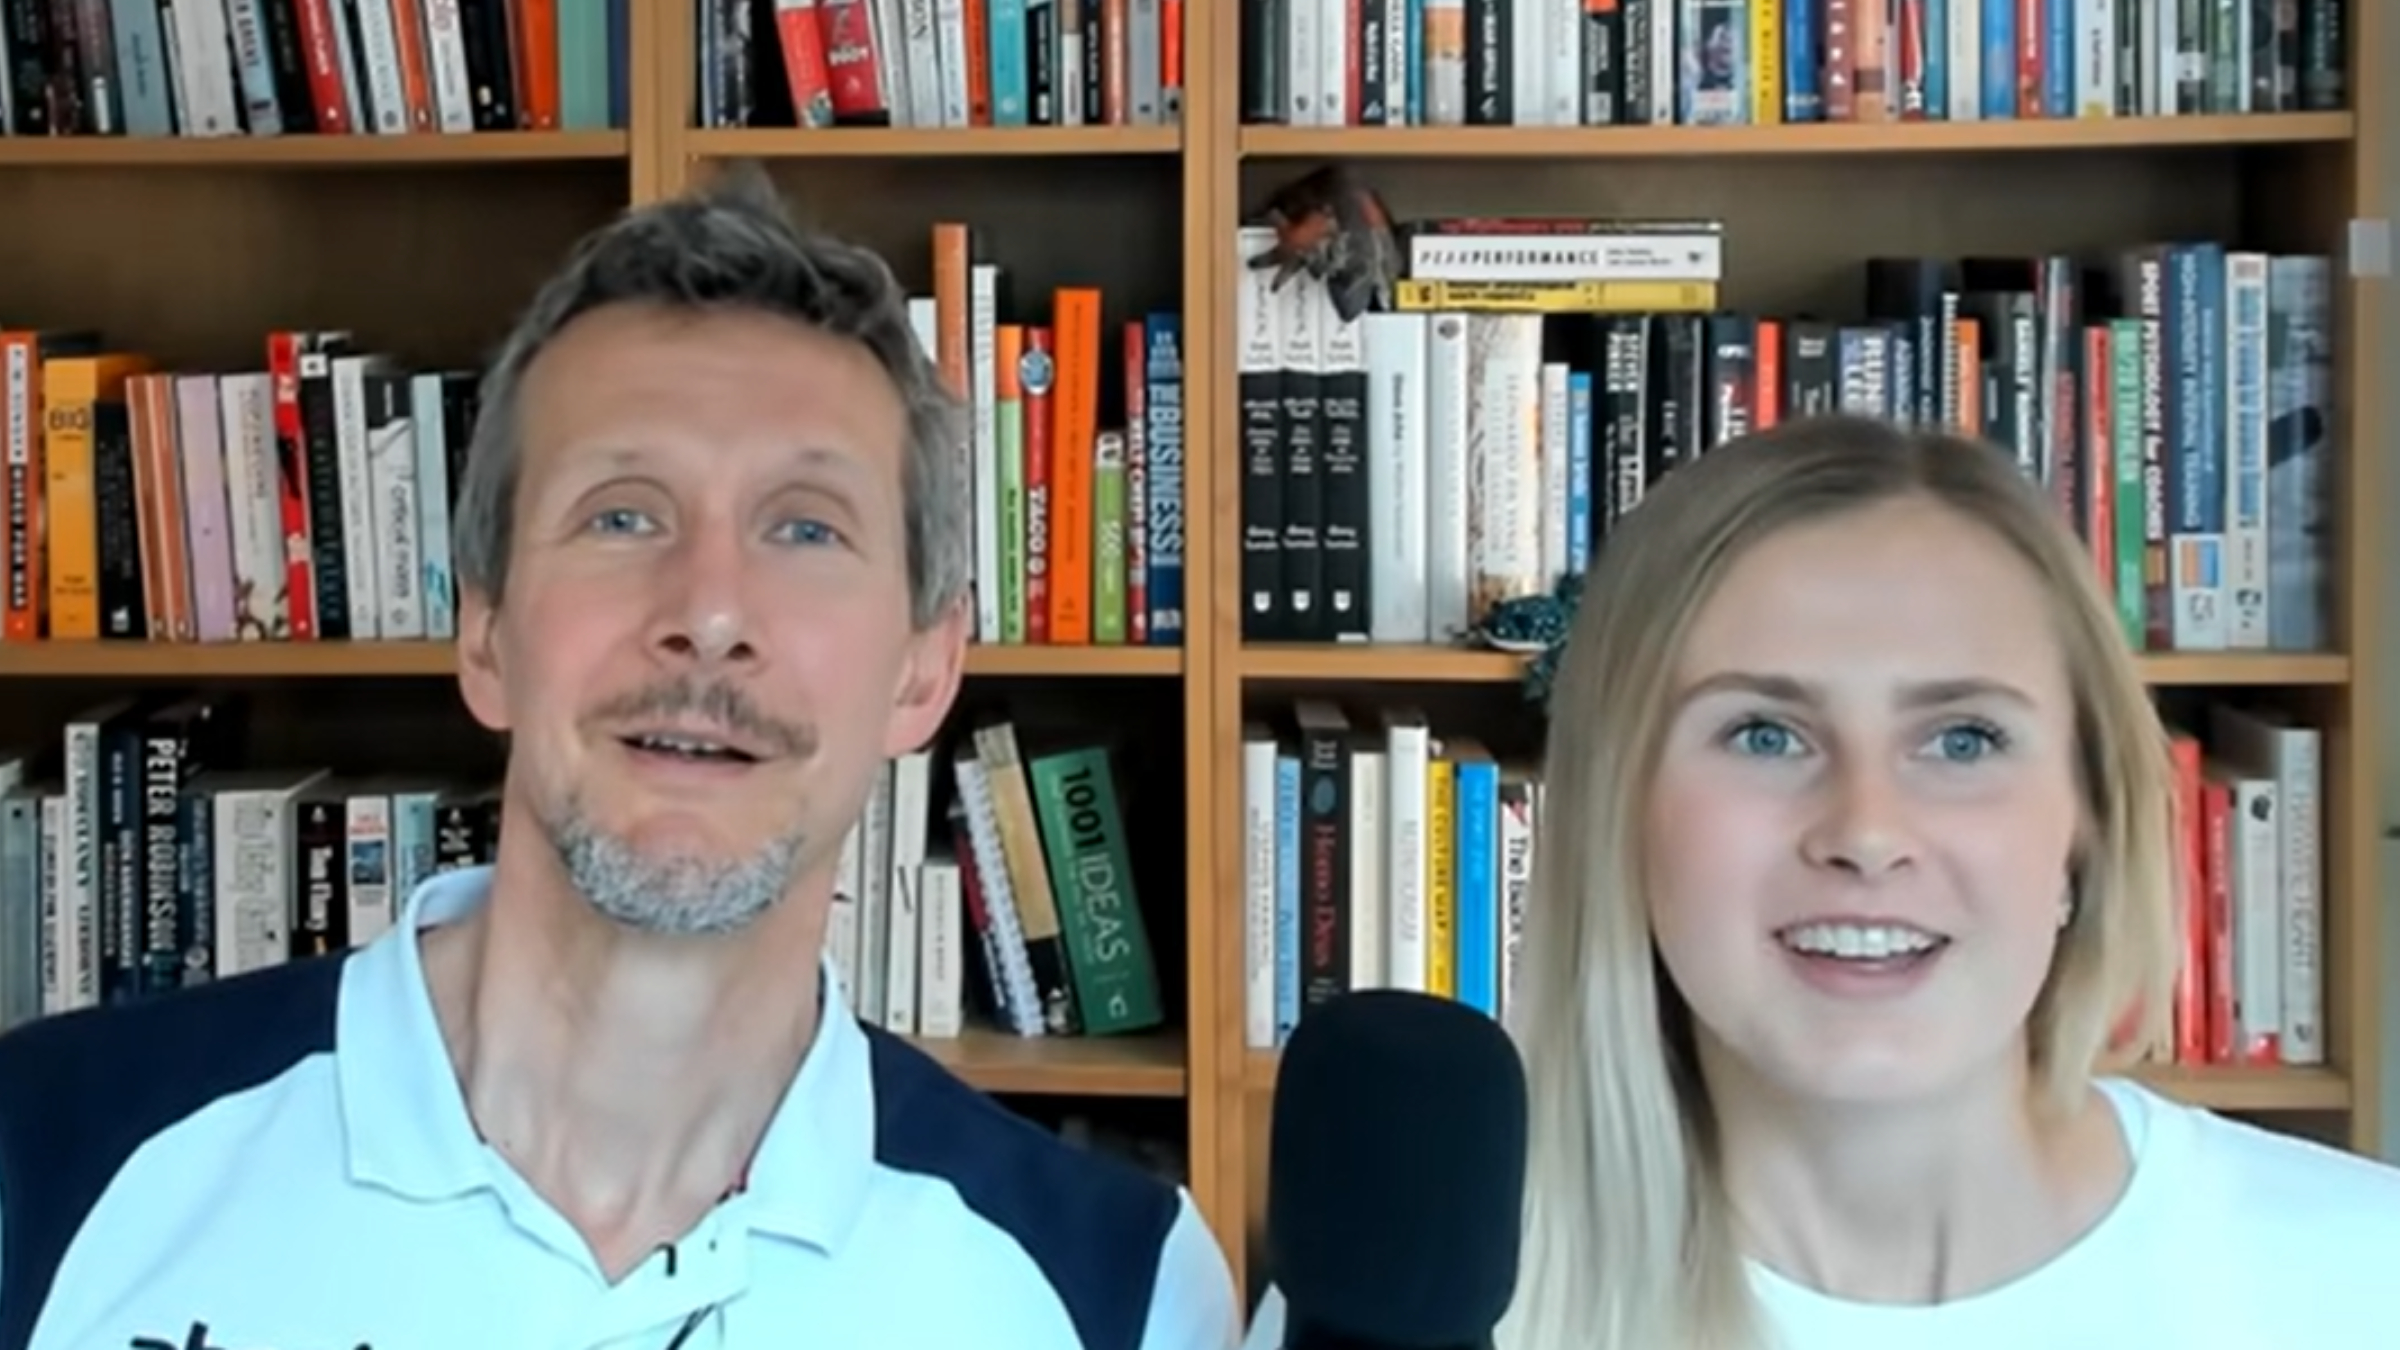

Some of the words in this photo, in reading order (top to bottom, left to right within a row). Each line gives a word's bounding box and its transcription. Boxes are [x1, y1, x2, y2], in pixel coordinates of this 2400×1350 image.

[148, 738, 176, 816] PETER
[1061, 767, 1106, 849] 1001
[148, 824, 176, 951] ROBINSON
[1316, 824, 1337, 899] Homo
[1508, 837, 1526, 875] The
[1079, 854, 1129, 962] IDEAS
[1316, 906, 1336, 966] Deus
